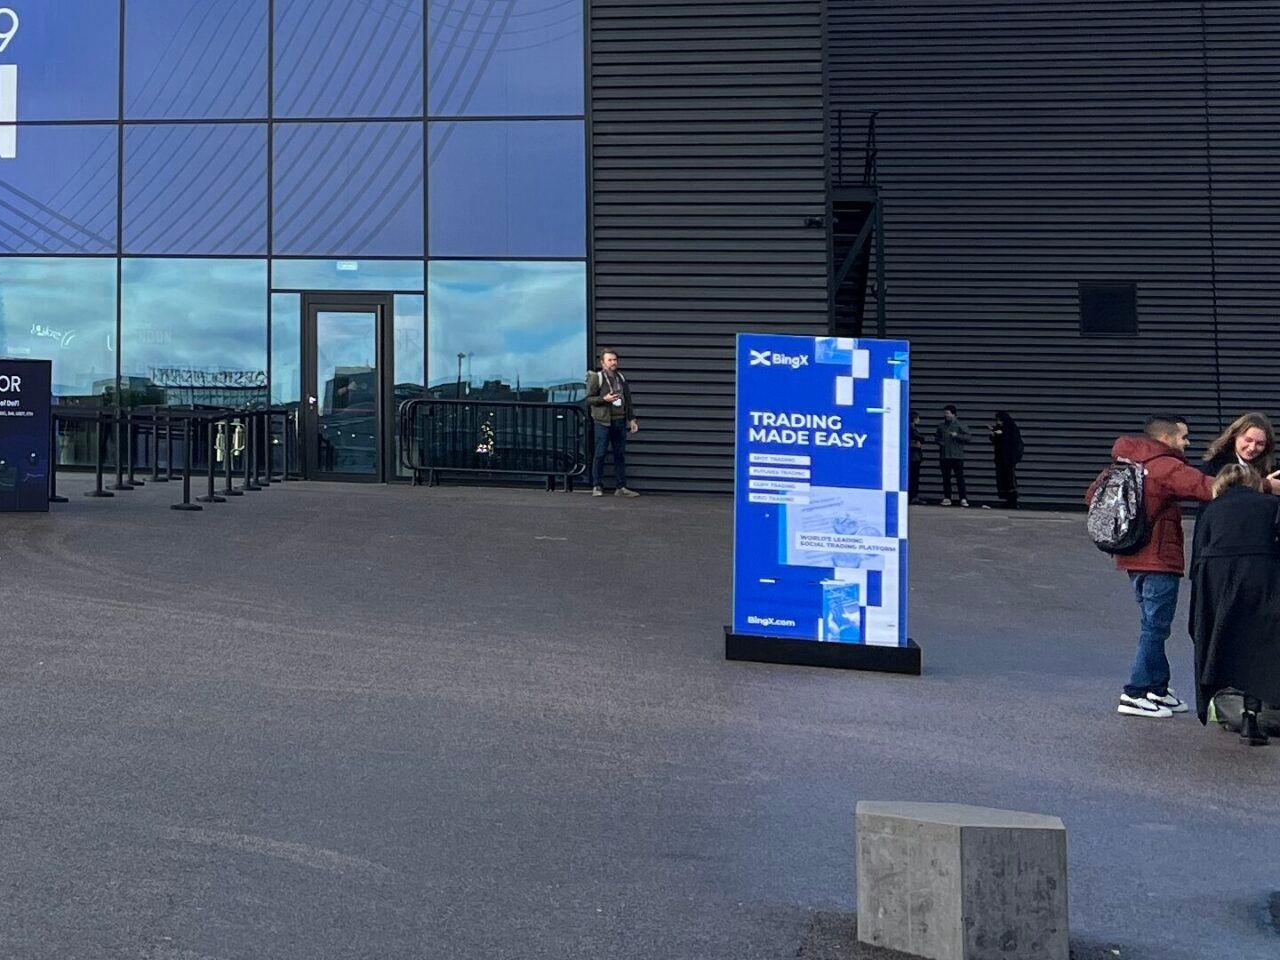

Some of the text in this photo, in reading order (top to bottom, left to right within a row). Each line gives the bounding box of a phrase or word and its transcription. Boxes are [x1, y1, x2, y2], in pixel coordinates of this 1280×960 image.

[772, 353, 809, 369] BingX
[749, 411, 842, 430] TRADING
[749, 428, 868, 448] MADE EASY
[826, 542, 857, 550] TRADING
[858, 544, 896, 552] PLATFORM
[747, 615, 796, 627] BingX.com
